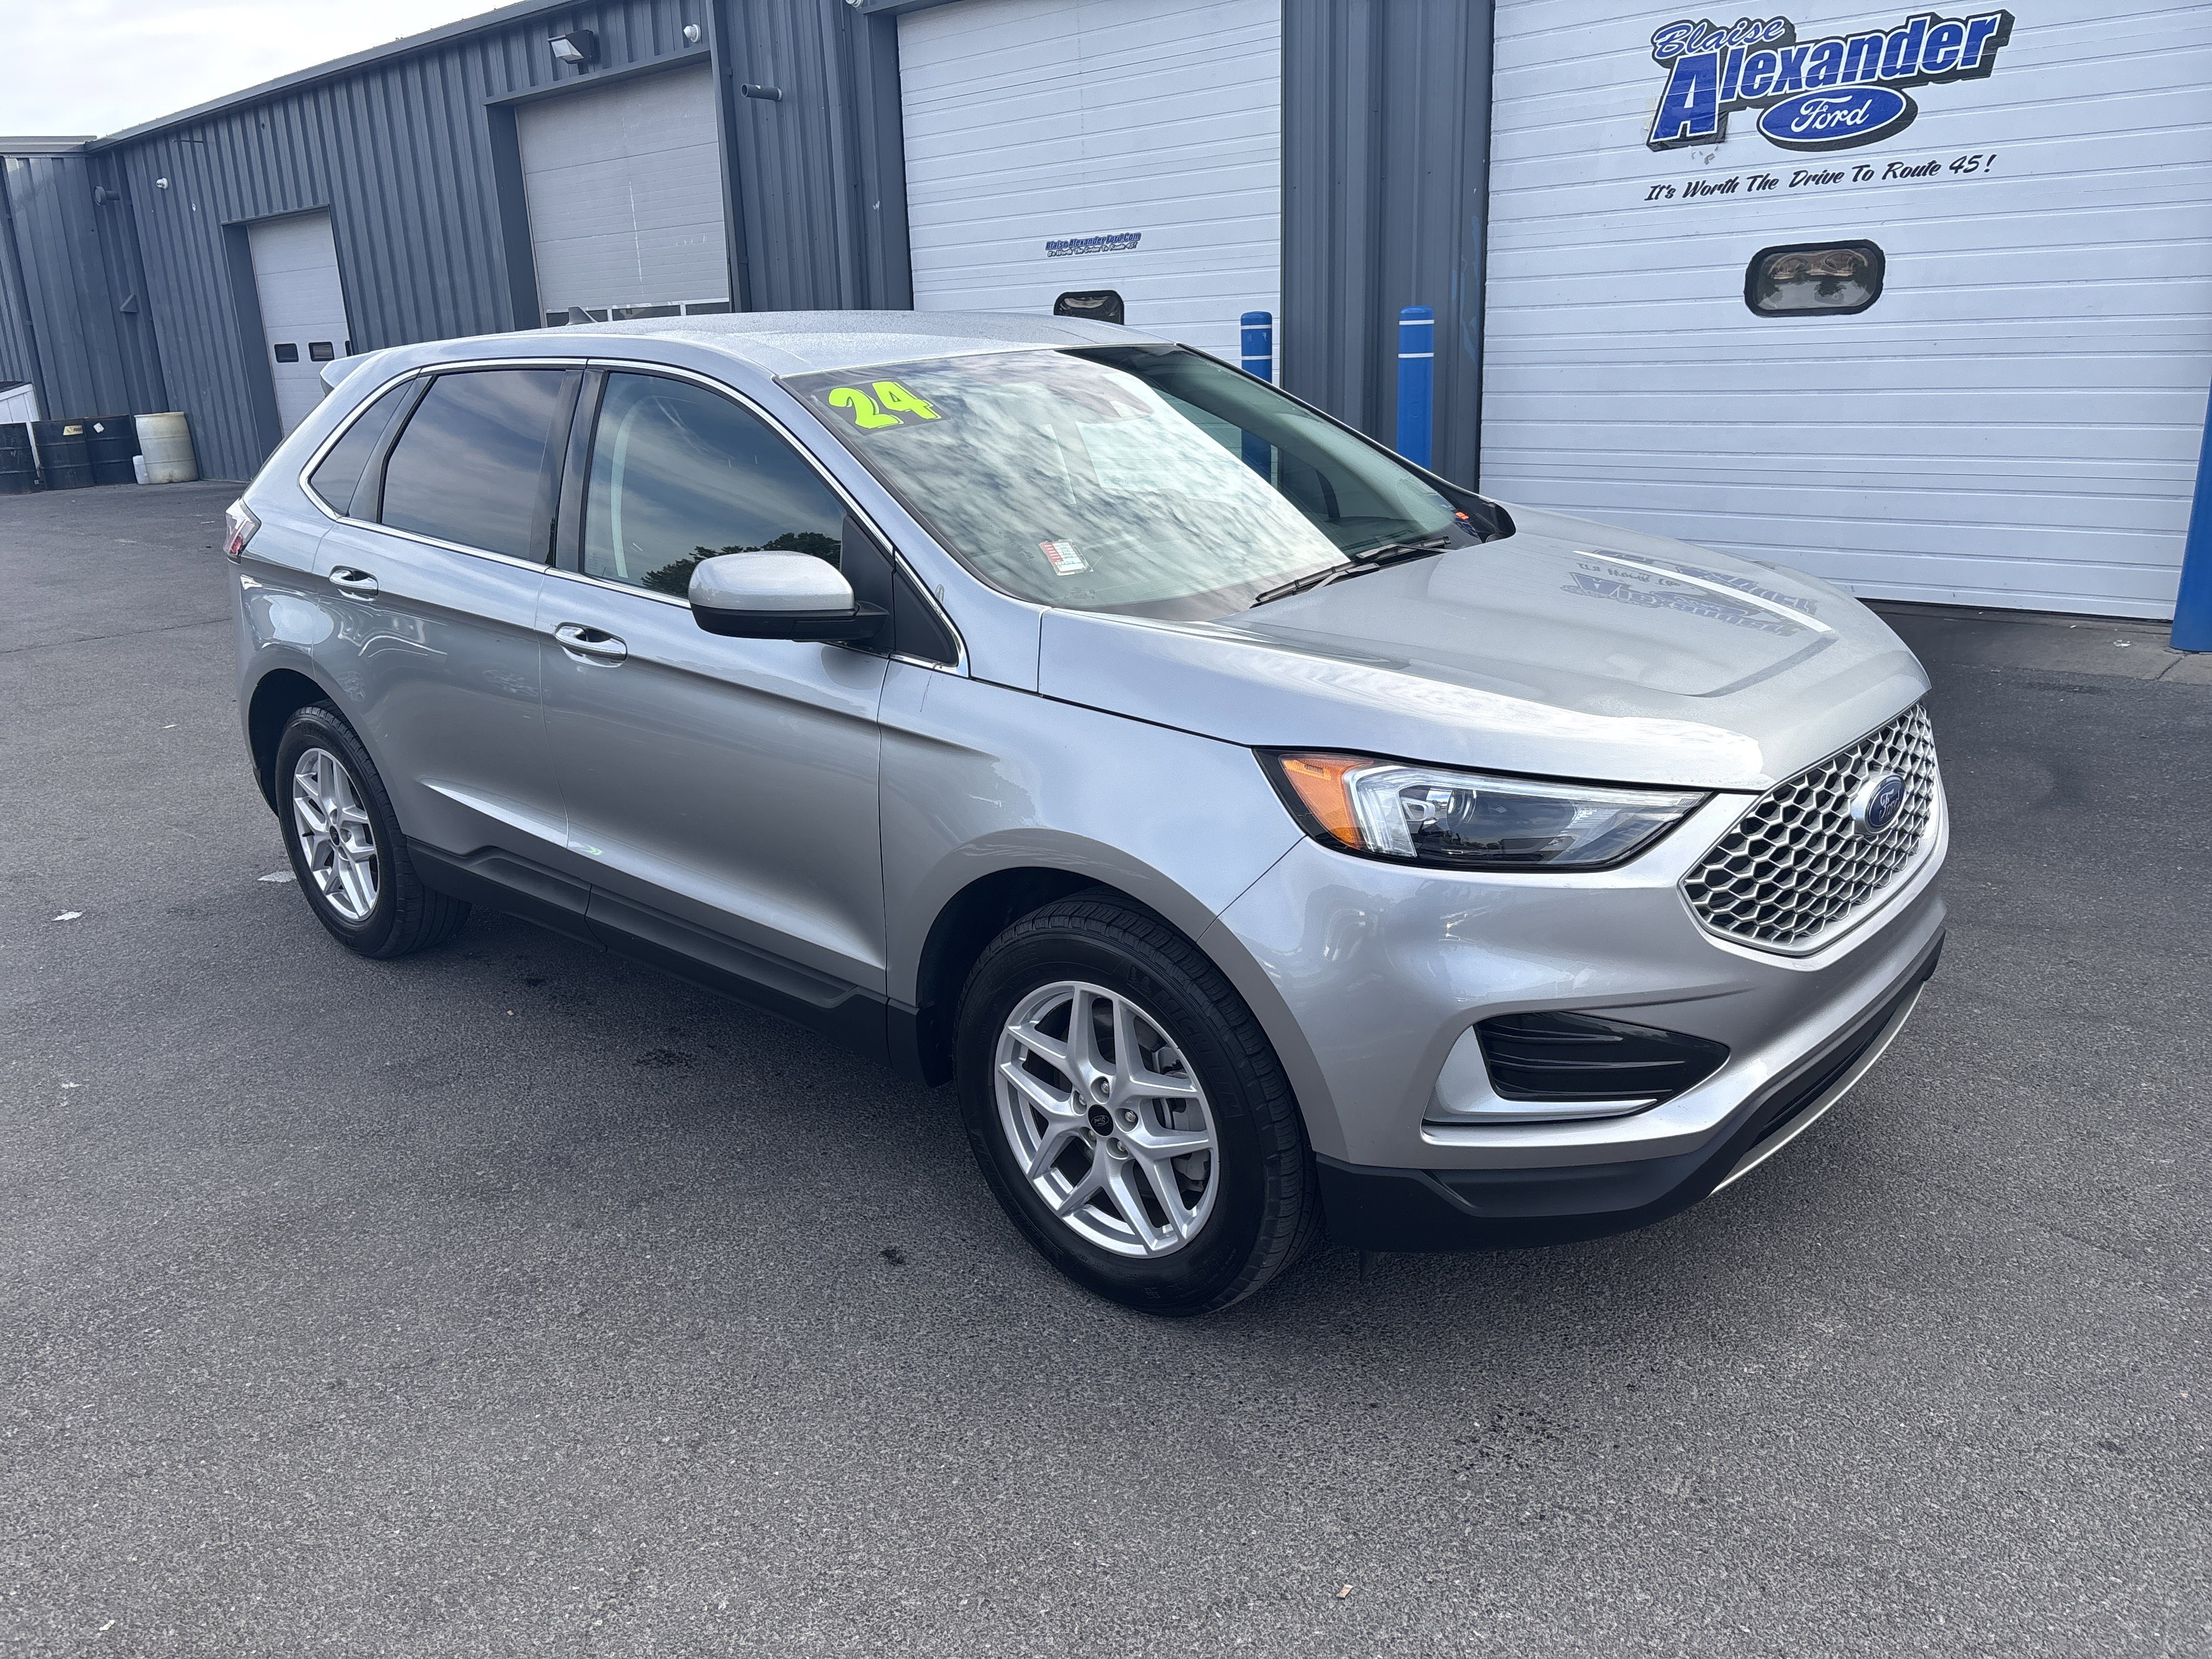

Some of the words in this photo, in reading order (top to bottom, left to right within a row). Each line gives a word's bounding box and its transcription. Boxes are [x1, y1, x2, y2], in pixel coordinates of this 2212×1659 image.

[1654, 18, 1786, 60] Blaise
[1648, 11, 2005, 145] Alexander
[1790, 94, 1870, 131] Ford
[1644, 184, 1677, 201] It's
[1681, 176, 1740, 199] Worth
[1746, 173, 1780, 193] The
[1788, 169, 1846, 189] Drive
[1851, 163, 1875, 183] To
[1881, 160, 1942, 180] Route
[1949, 154, 1997, 175] 45!
[1069, 236, 1106, 248] Alexander
[828, 381, 942, 430] 24
[1878, 788, 1900, 822] Ford
[1153, 988, 1246, 1119] MICHELIN
